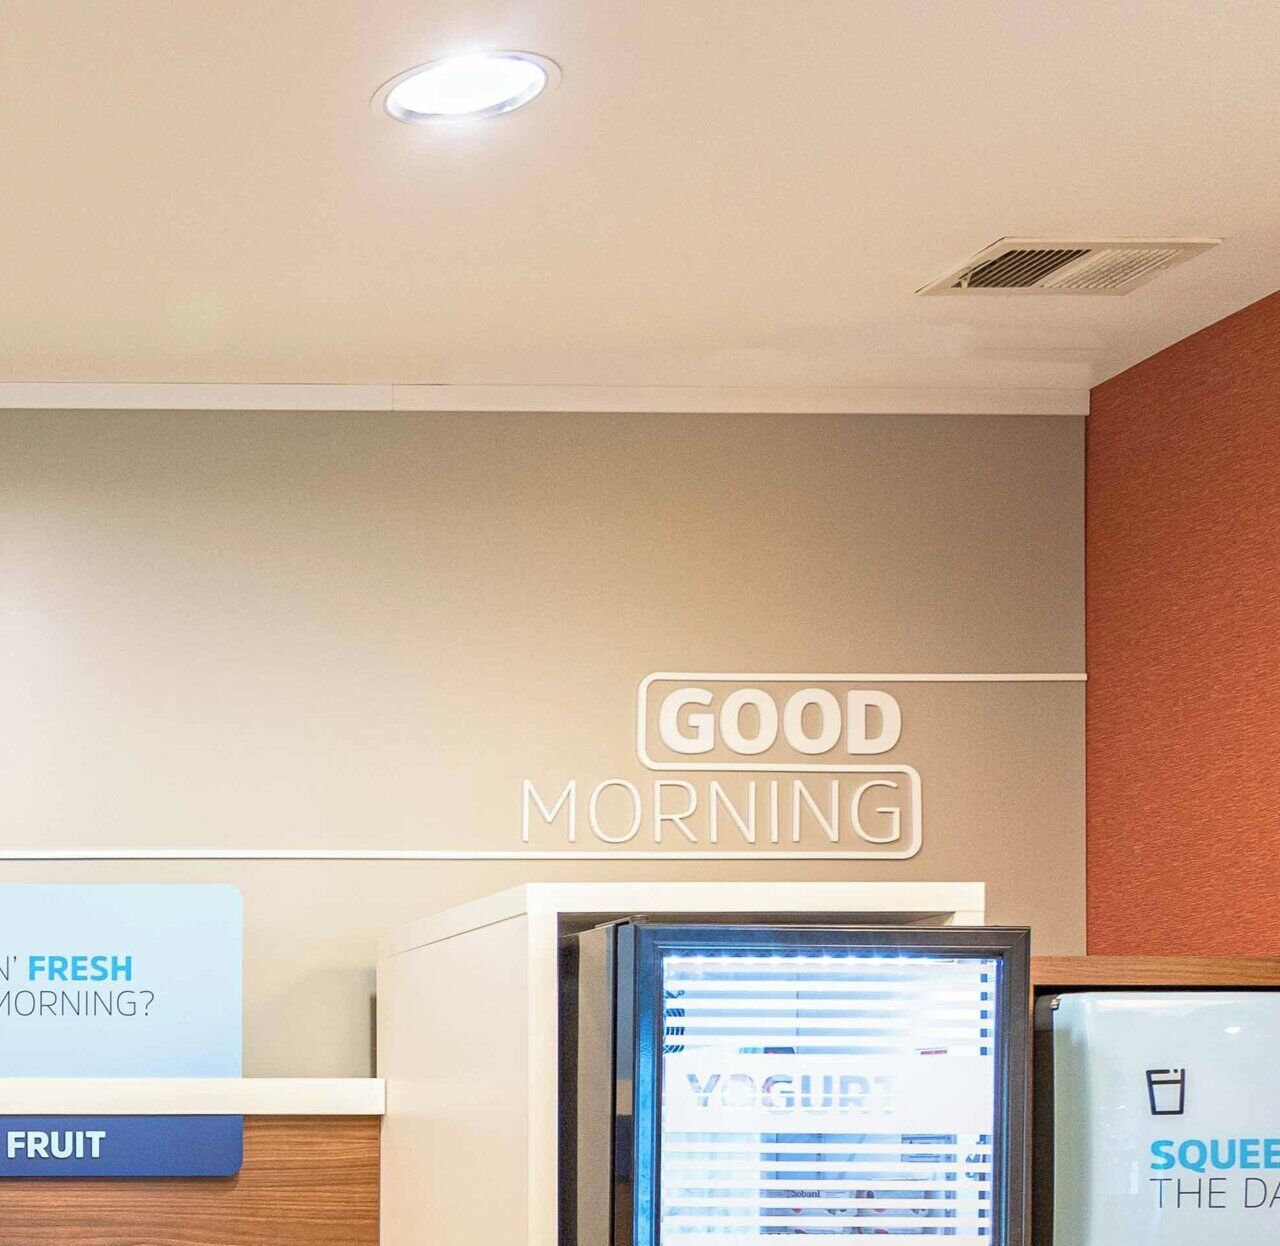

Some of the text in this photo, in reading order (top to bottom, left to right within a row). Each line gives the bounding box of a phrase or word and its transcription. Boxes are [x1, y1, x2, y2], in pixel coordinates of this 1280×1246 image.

[658, 688, 903, 755] GOOD
[519, 779, 902, 844] MORNING
[28, 955, 133, 982] FRESH
[686, 1073, 898, 1115] YOGURT
[6, 1130, 107, 1159] FRUIT
[1149, 1177, 1227, 1209] THE
